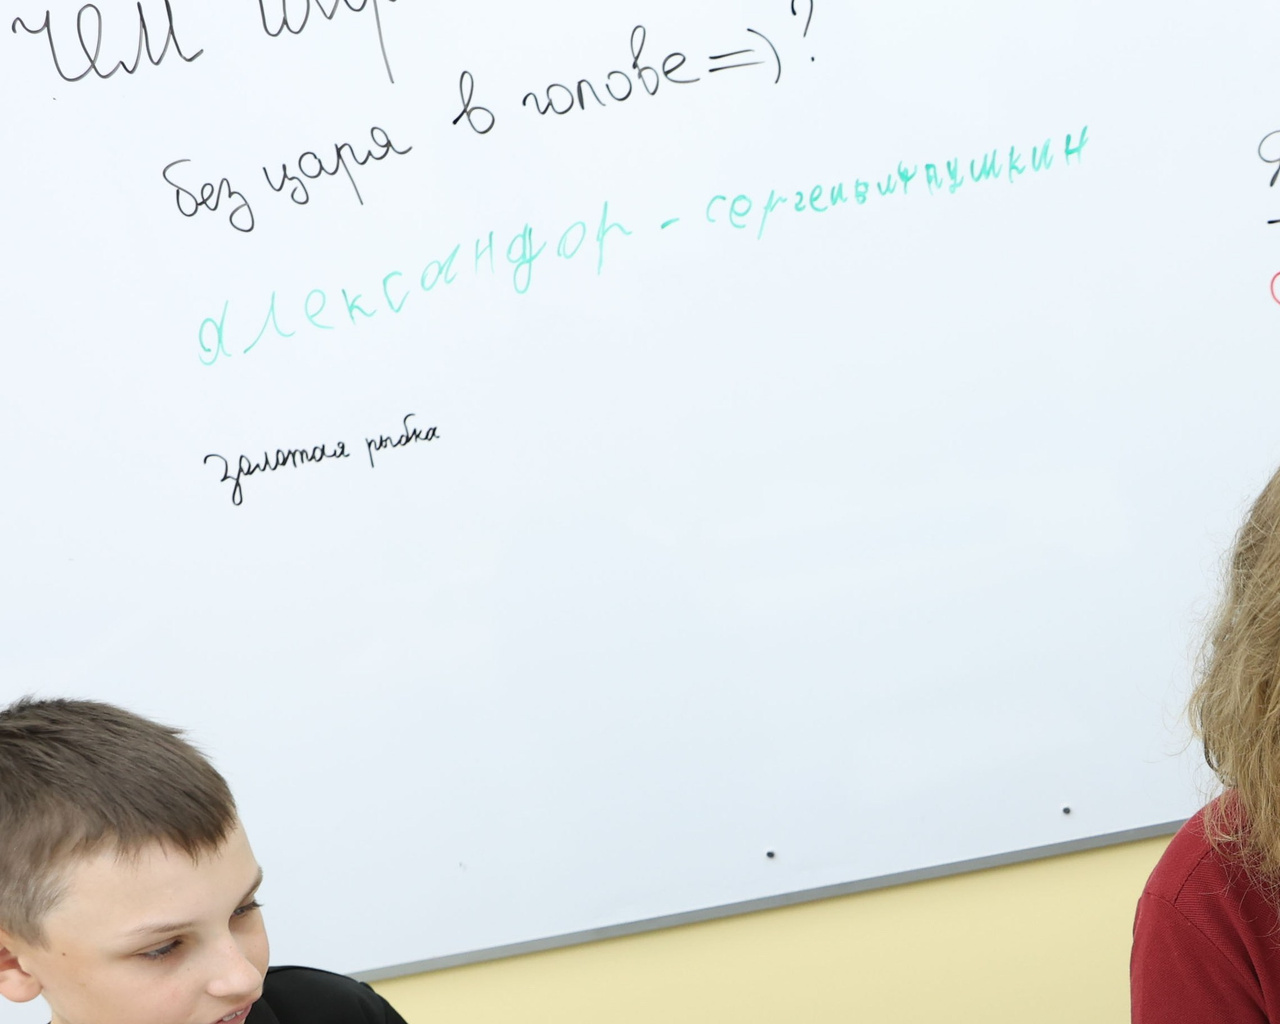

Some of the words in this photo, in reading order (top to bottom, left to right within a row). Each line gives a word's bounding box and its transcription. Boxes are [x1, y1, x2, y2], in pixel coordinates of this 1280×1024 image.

[263, 127, 413, 205] царя
[452, 70, 495, 134] в
[366, 413, 440, 468] рыбка
